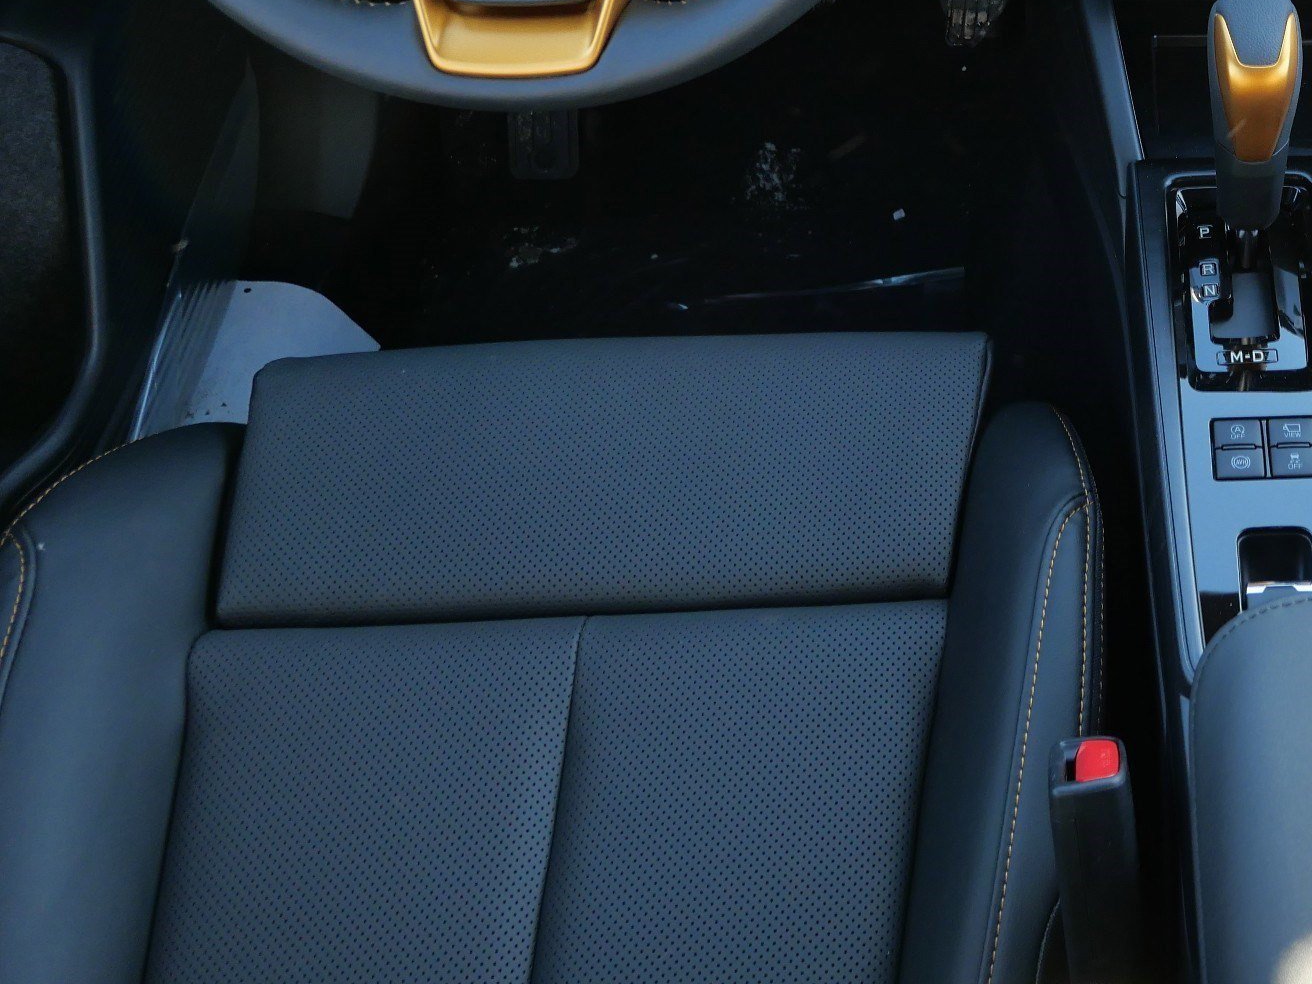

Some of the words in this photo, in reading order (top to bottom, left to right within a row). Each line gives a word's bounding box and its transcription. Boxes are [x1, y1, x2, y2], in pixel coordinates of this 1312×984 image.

[1199, 228, 1210, 238] P
[1202, 264, 1214, 275] R
[1203, 285, 1216, 296] N
